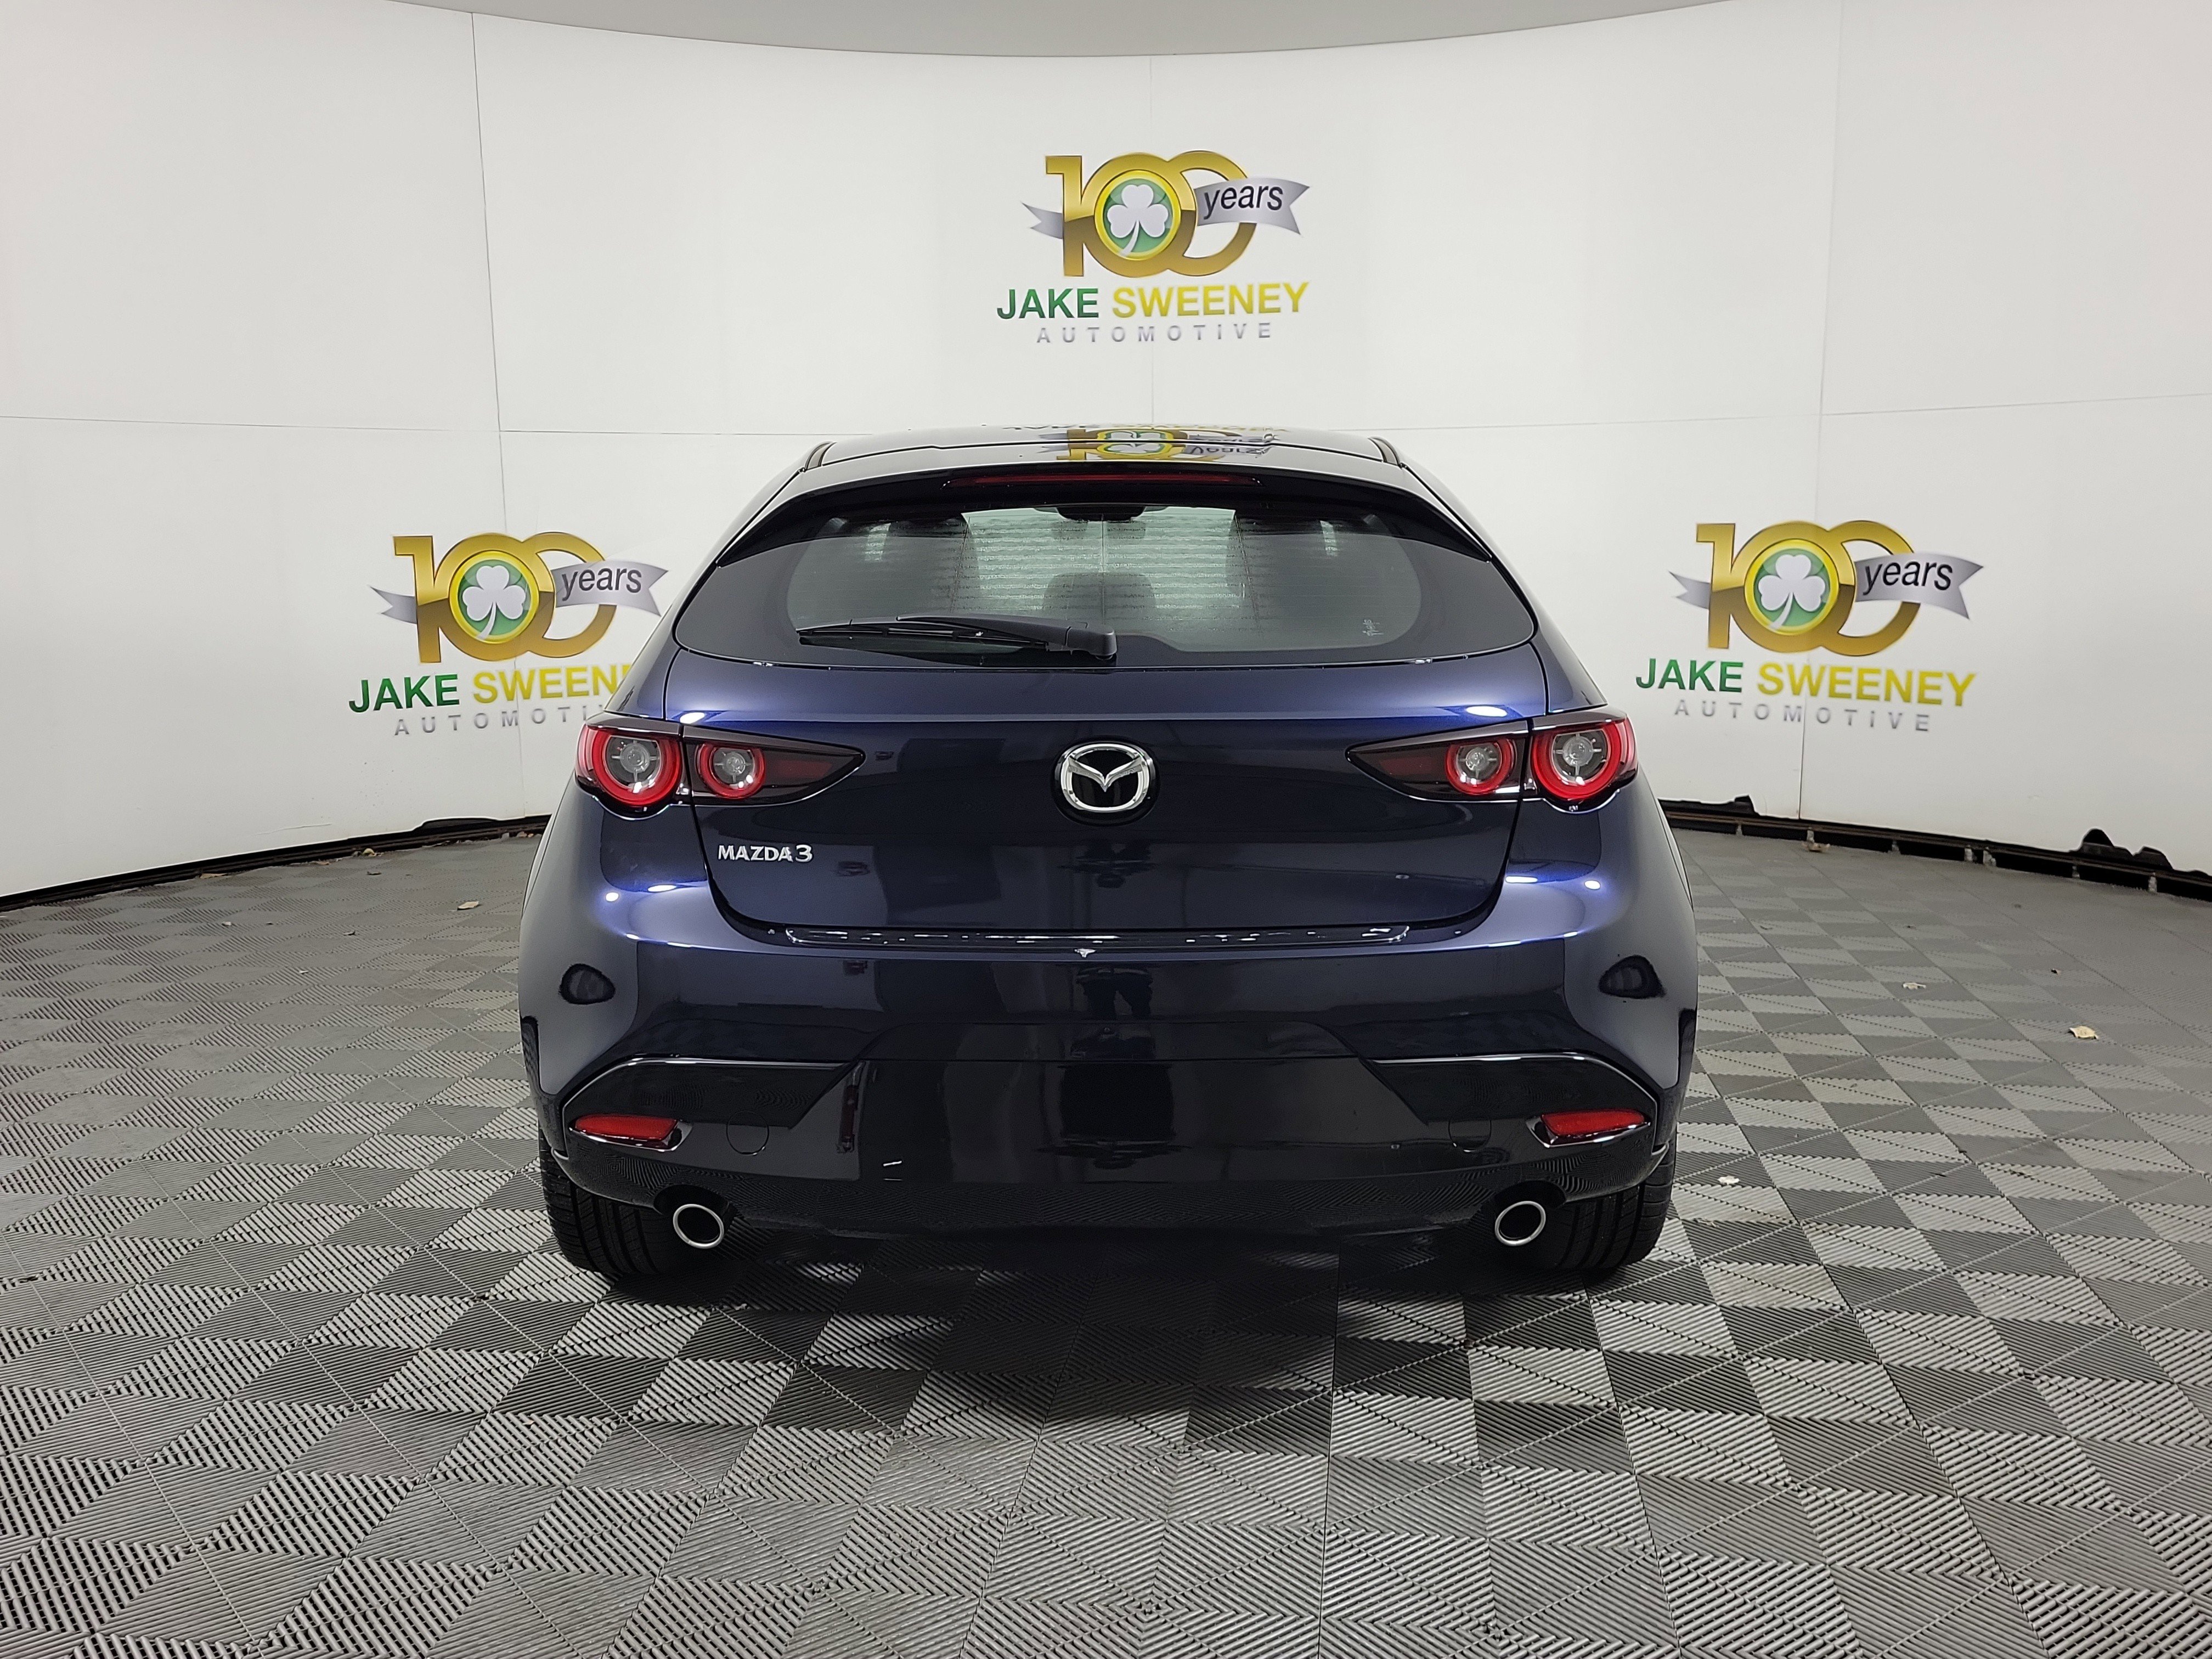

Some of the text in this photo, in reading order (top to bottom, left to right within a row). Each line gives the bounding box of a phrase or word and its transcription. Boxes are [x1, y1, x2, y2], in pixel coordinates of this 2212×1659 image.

[1203, 185, 1284, 219] years
[997, 281, 1310, 320] JAKE SWEENEY
[1036, 322, 1271, 344] AUTOMOTIVE
[561, 567, 642, 601] years
[1863, 558, 1954, 596] years
[349, 673, 459, 713] JAKE
[1635, 657, 1977, 707] JAKE SWEENEY
[394, 705, 602, 736] AUTOMOTI
[1675, 698, 1930, 732] AUTOMOTIVE
